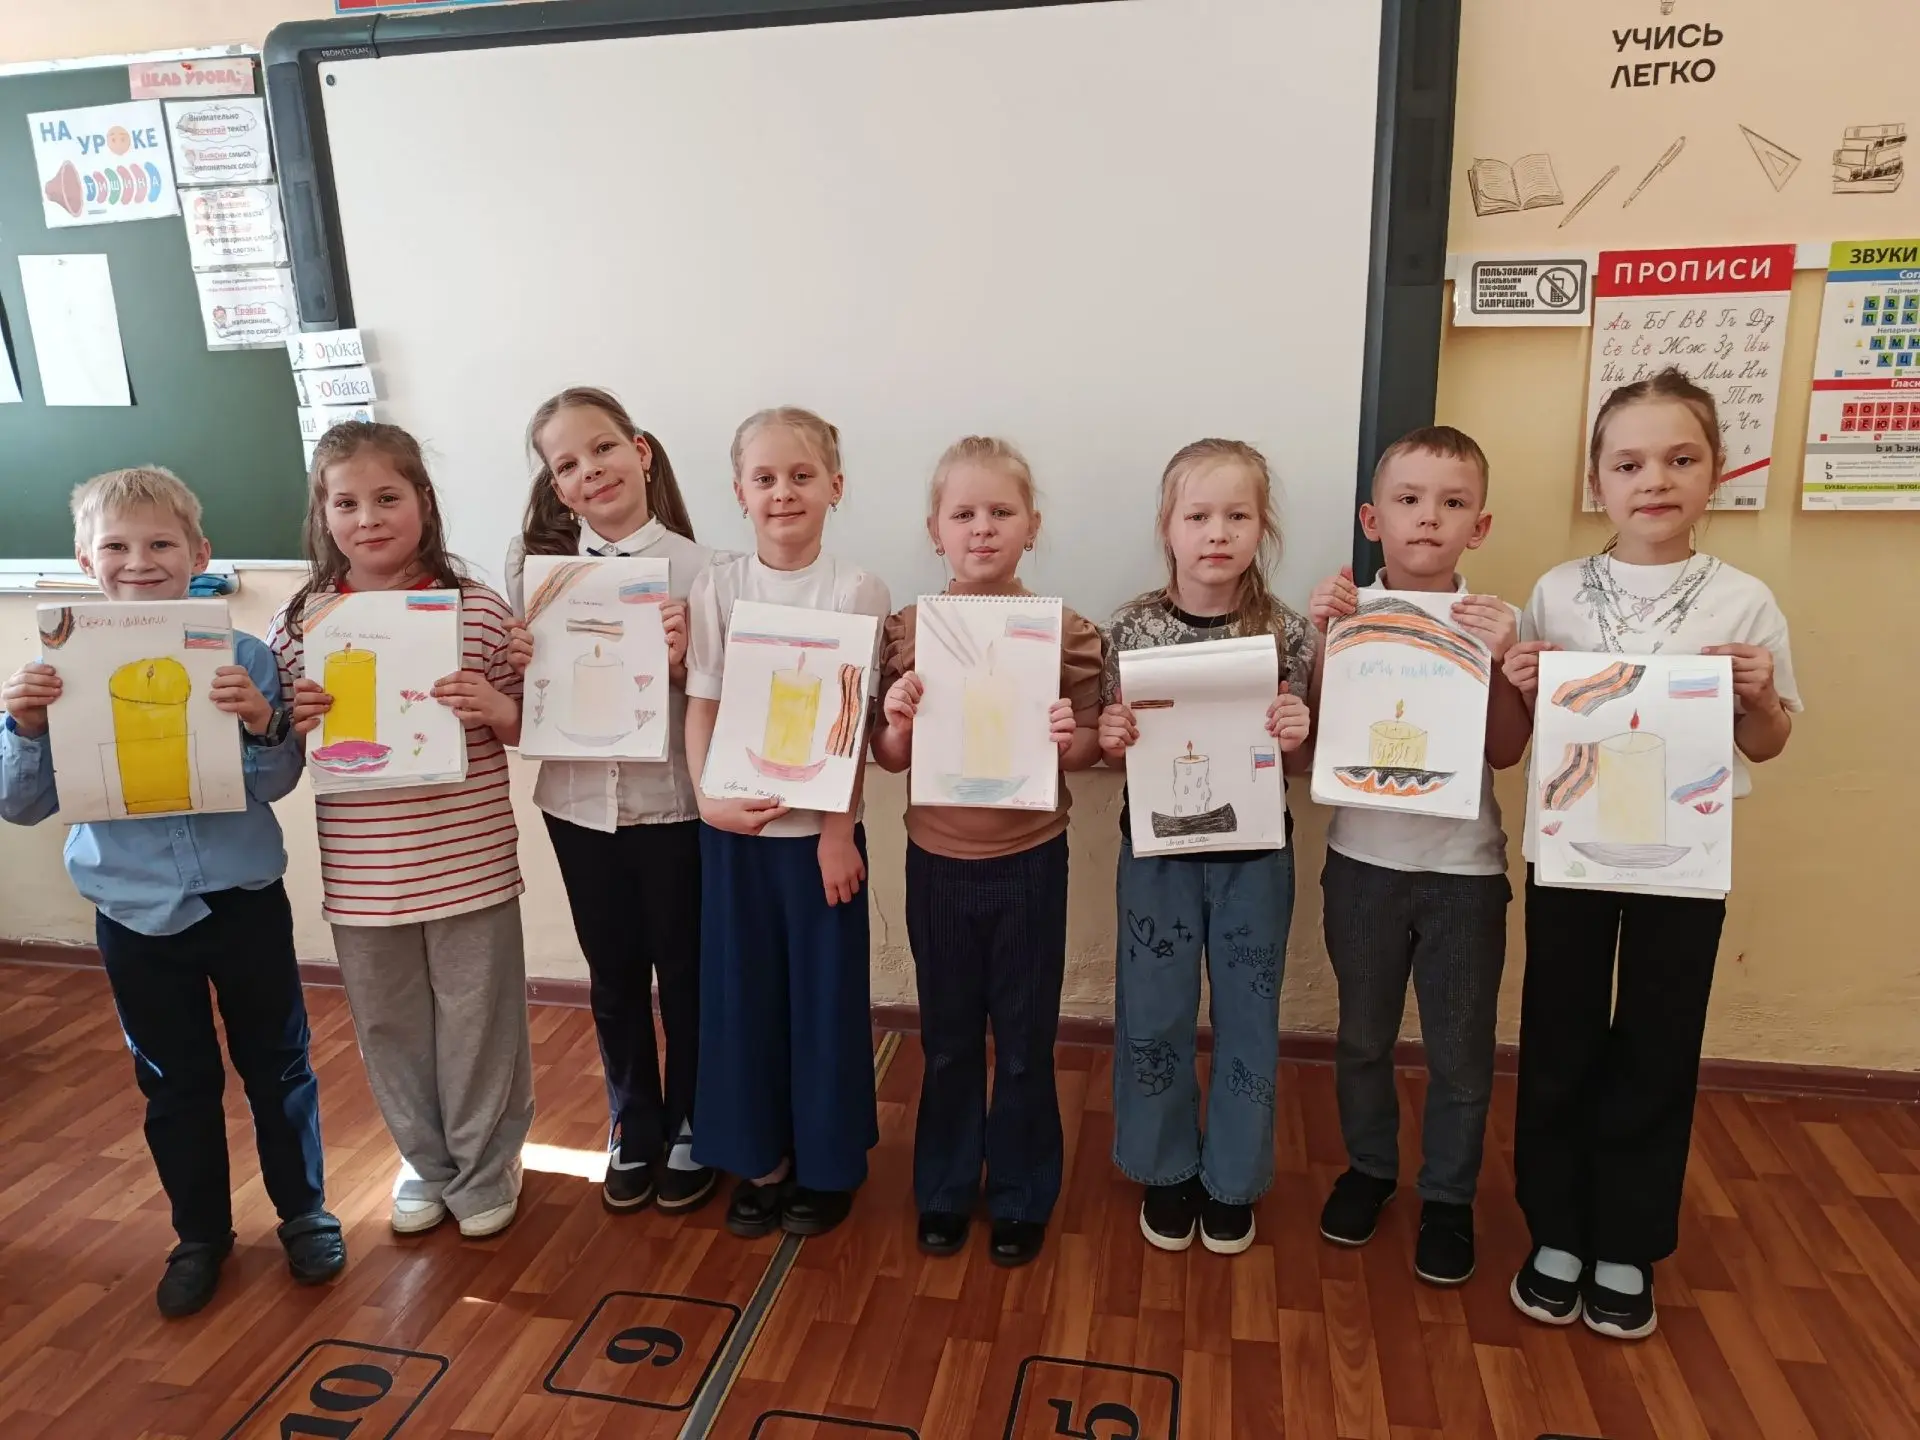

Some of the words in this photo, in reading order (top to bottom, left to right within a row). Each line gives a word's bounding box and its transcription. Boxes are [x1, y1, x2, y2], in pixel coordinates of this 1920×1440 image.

[1612, 23, 1723, 52] УЧИСЬ
[321, 48, 369, 56] PROMETHEAN
[141, 72, 181, 87] ЦЕЛЬ
[1610, 58, 1716, 88] ЛЕГКО
[40, 120, 72, 142] НА
[87, 175, 159, 193] ТИШИНА
[1849, 247, 1918, 264] ЗВУКИ
[1480, 267, 1538, 276] ПОЛЬЗОВАНИЕ
[1614, 257, 1771, 284] ПРОПИСИ
[1478, 298, 1534, 308] ЗАПРЕЩЕНО!
[1604, 312, 1632, 330] Аа
[1643, 310, 1676, 329] Бб
[1678, 310, 1707, 328] Вв
[1716, 308, 1737, 327] Гг
[1746, 308, 1774, 333] Дд
[1602, 336, 1622, 356] Ее
[1659, 336, 1706, 354] Жж
[1714, 334, 1734, 360] Зз
[1744, 334, 1770, 352] Ии
[1601, 360, 1624, 382] Йй
[1694, 361, 1734, 380] Мм
[1738, 360, 1768, 378] Нн
[1722, 386, 1764, 404] Тт
[1738, 411, 1761, 430] Чч
[606, 1326, 684, 1368] 9
[280, 1364, 394, 1440] 10
